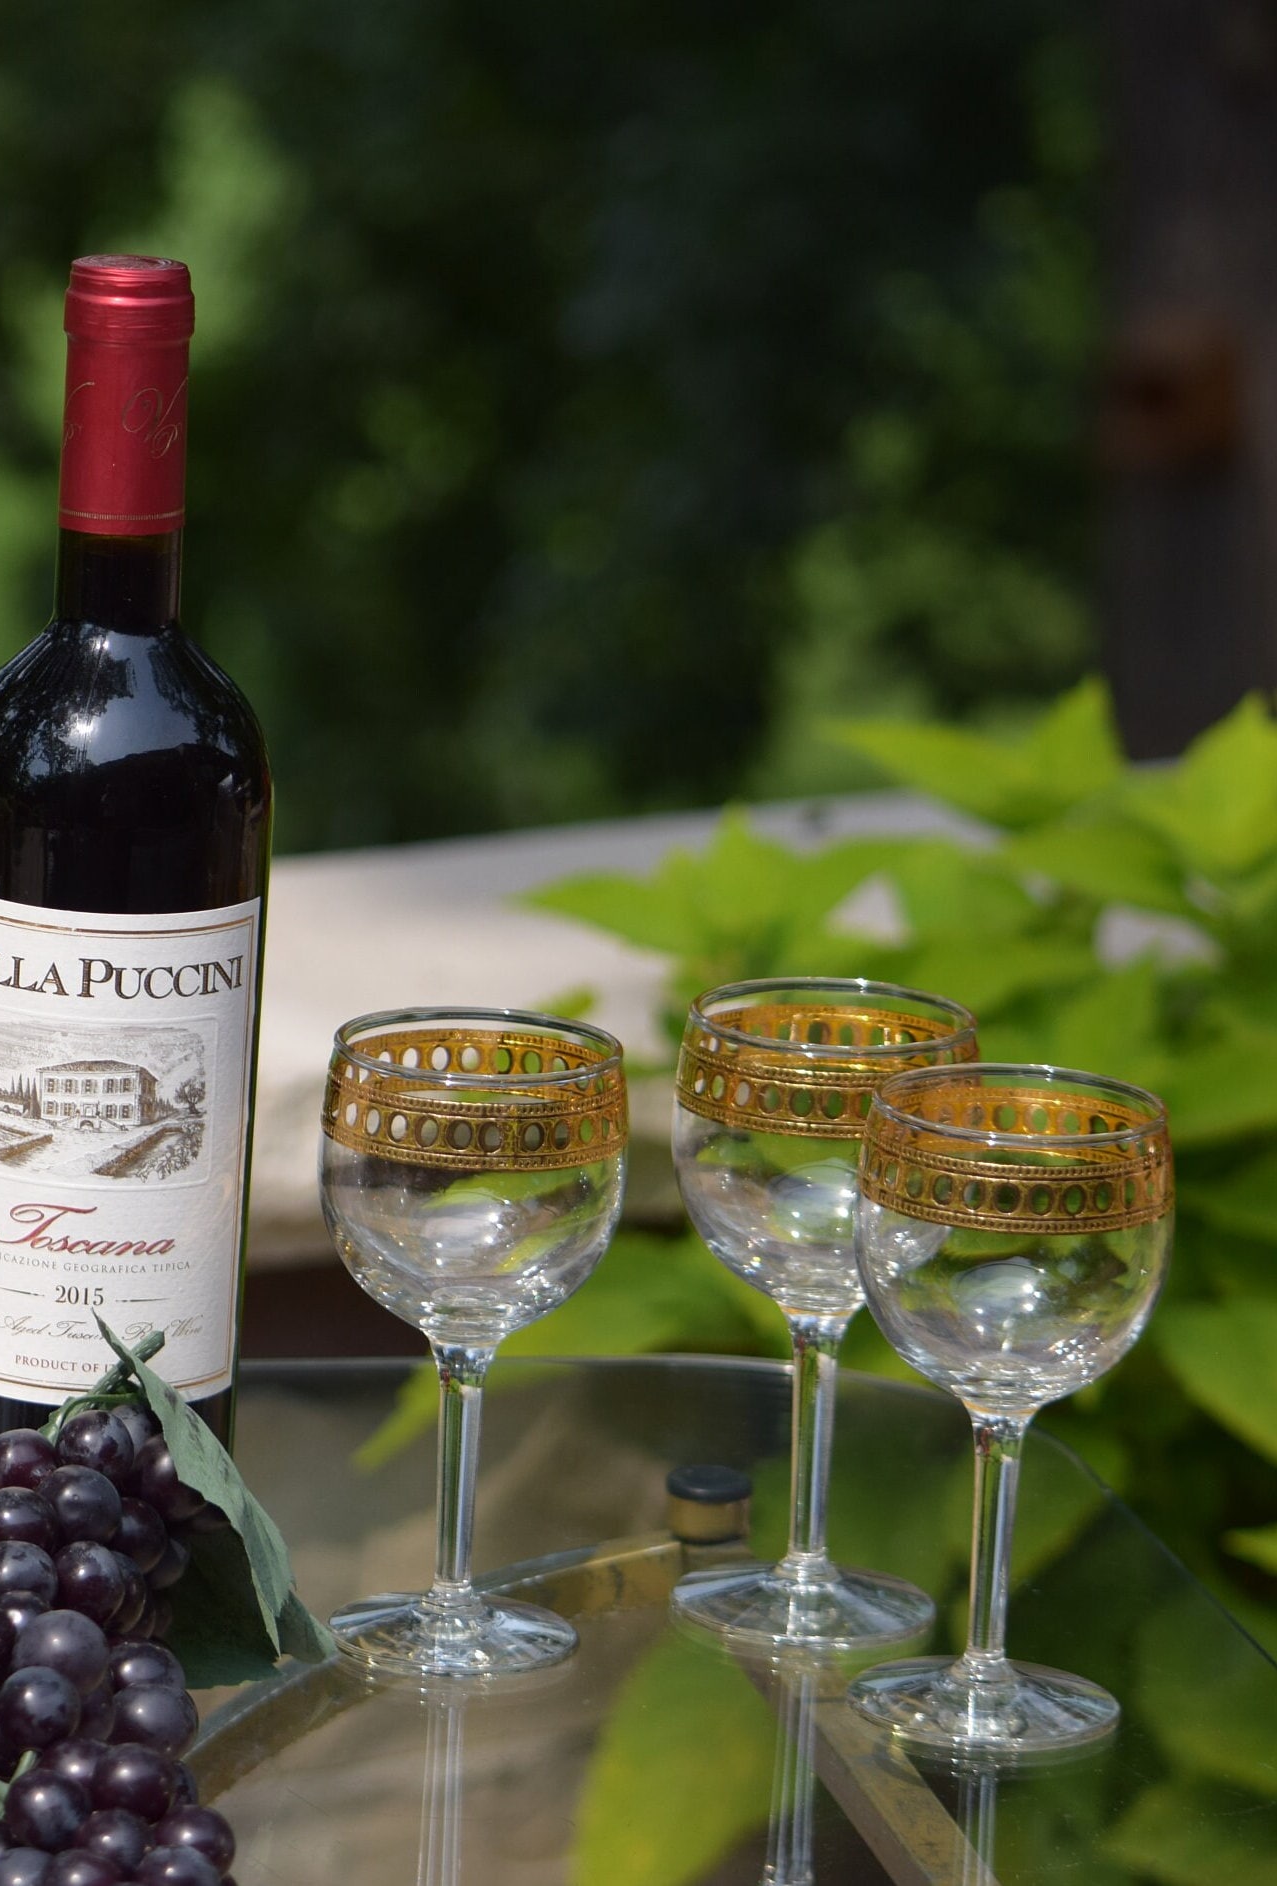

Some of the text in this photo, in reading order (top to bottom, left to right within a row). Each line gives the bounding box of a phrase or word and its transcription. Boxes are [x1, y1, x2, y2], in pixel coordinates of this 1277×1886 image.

[77, 954, 243, 1000] PUCCINI
[63, 1262, 146, 1274] GEOGRAFICA
[153, 1261, 190, 1273] TIPICA
[55, 1285, 104, 1306] 2015
[15, 1354, 77, 1372] PRODUCT
[82, 1363, 99, 1373] OF
